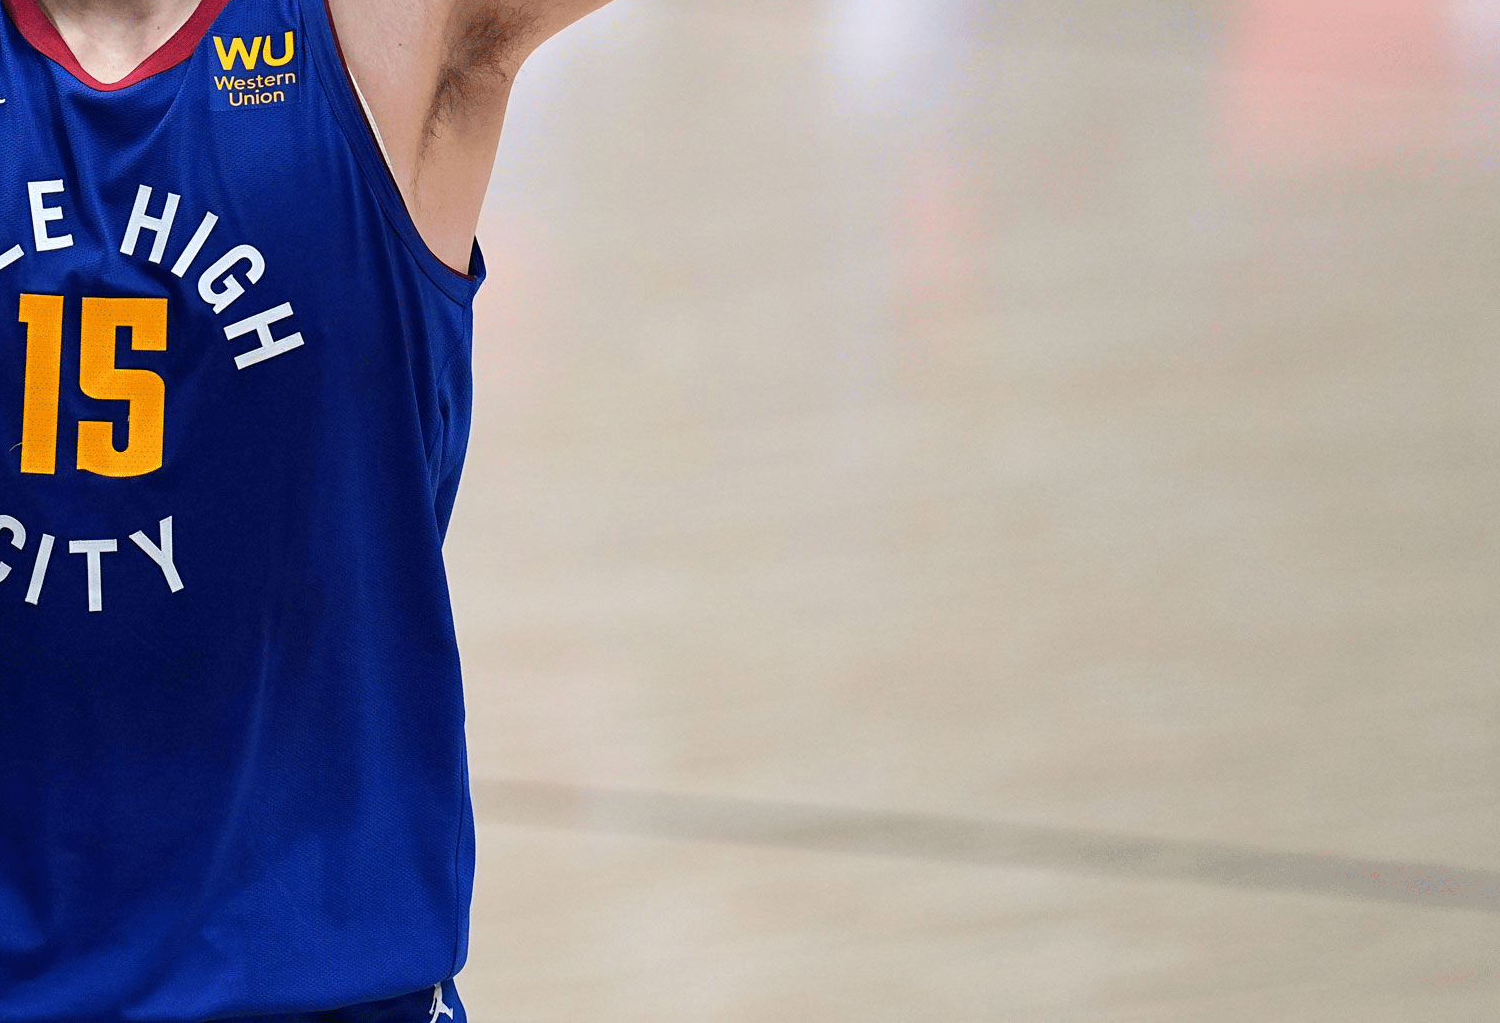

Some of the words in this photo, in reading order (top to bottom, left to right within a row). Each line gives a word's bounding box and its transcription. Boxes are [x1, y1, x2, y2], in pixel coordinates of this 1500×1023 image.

[212, 30, 295, 71] WU
[213, 72, 296, 91] Western
[229, 89, 285, 107] Union
[119, 184, 305, 371] HIGH
[17, 293, 169, 478] 15
